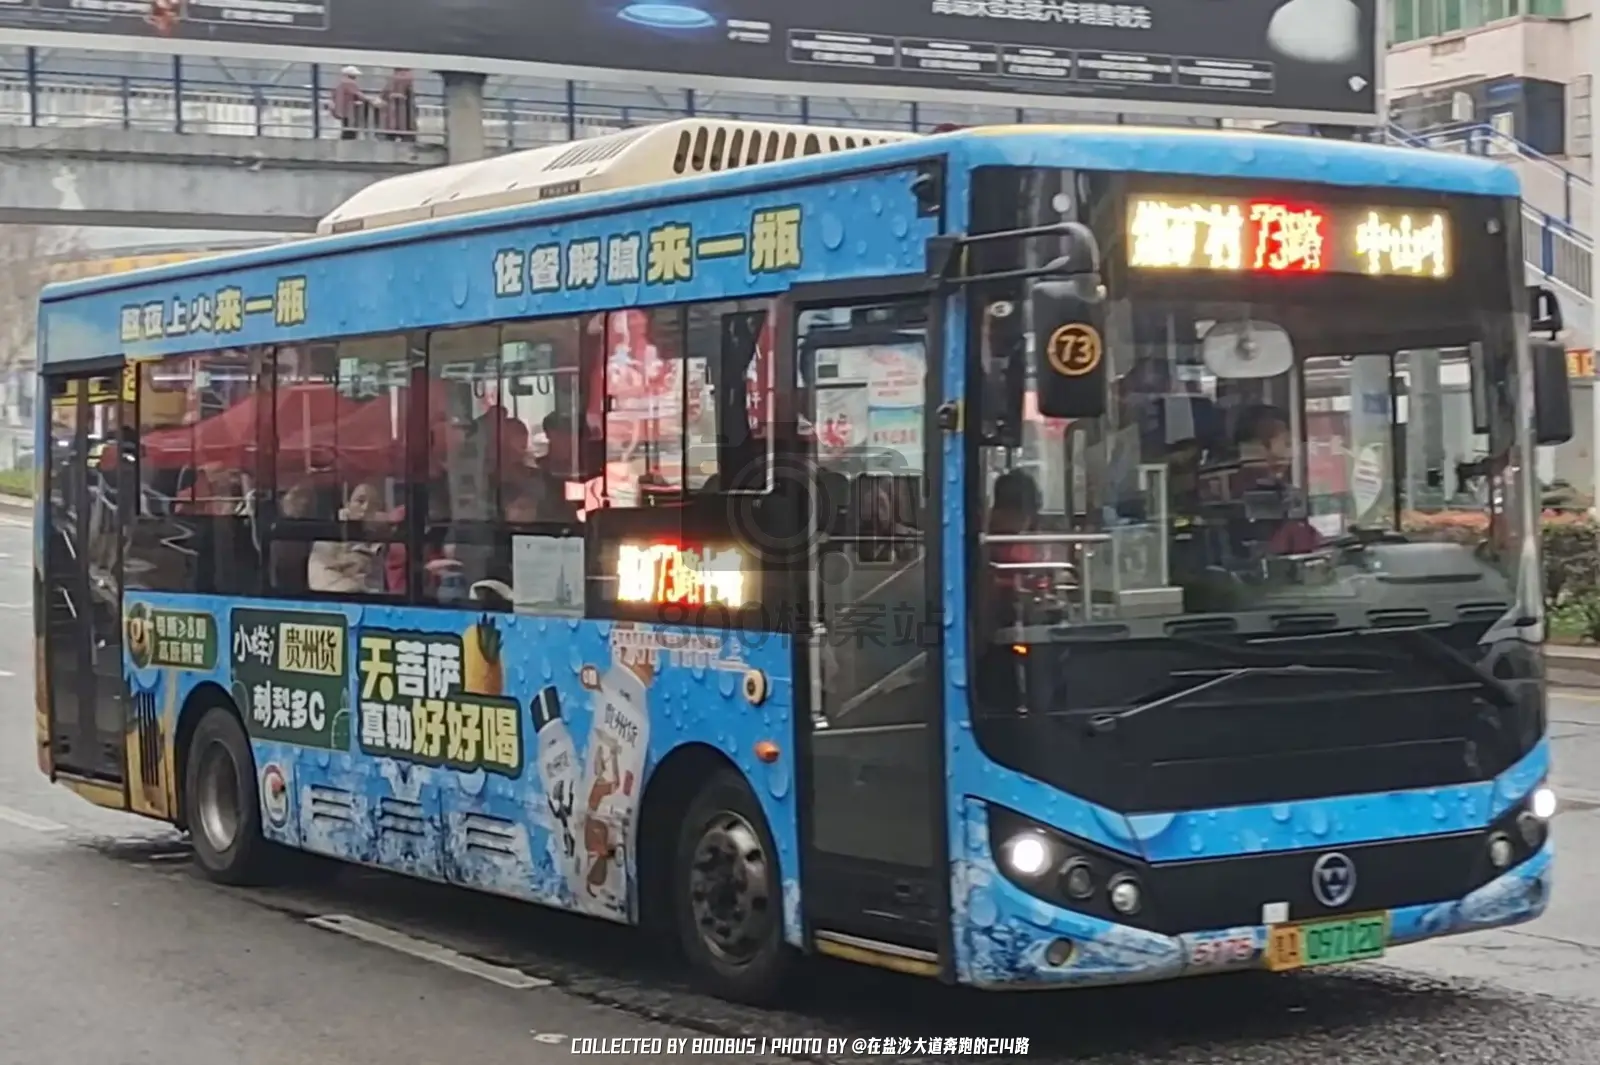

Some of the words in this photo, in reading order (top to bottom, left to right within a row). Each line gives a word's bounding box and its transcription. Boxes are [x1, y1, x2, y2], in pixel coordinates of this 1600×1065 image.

[493, 206, 801, 295] 佐餐解腻来一瓶
[1250, 203, 1323, 270] 73路
[1060, 335, 1092, 363] 73
[285, 626, 338, 673] 贵州货
[360, 636, 461, 701] 天菩萨
[253, 680, 326, 731] 刺梨多C
[360, 697, 519, 769] 真勒好好喝
